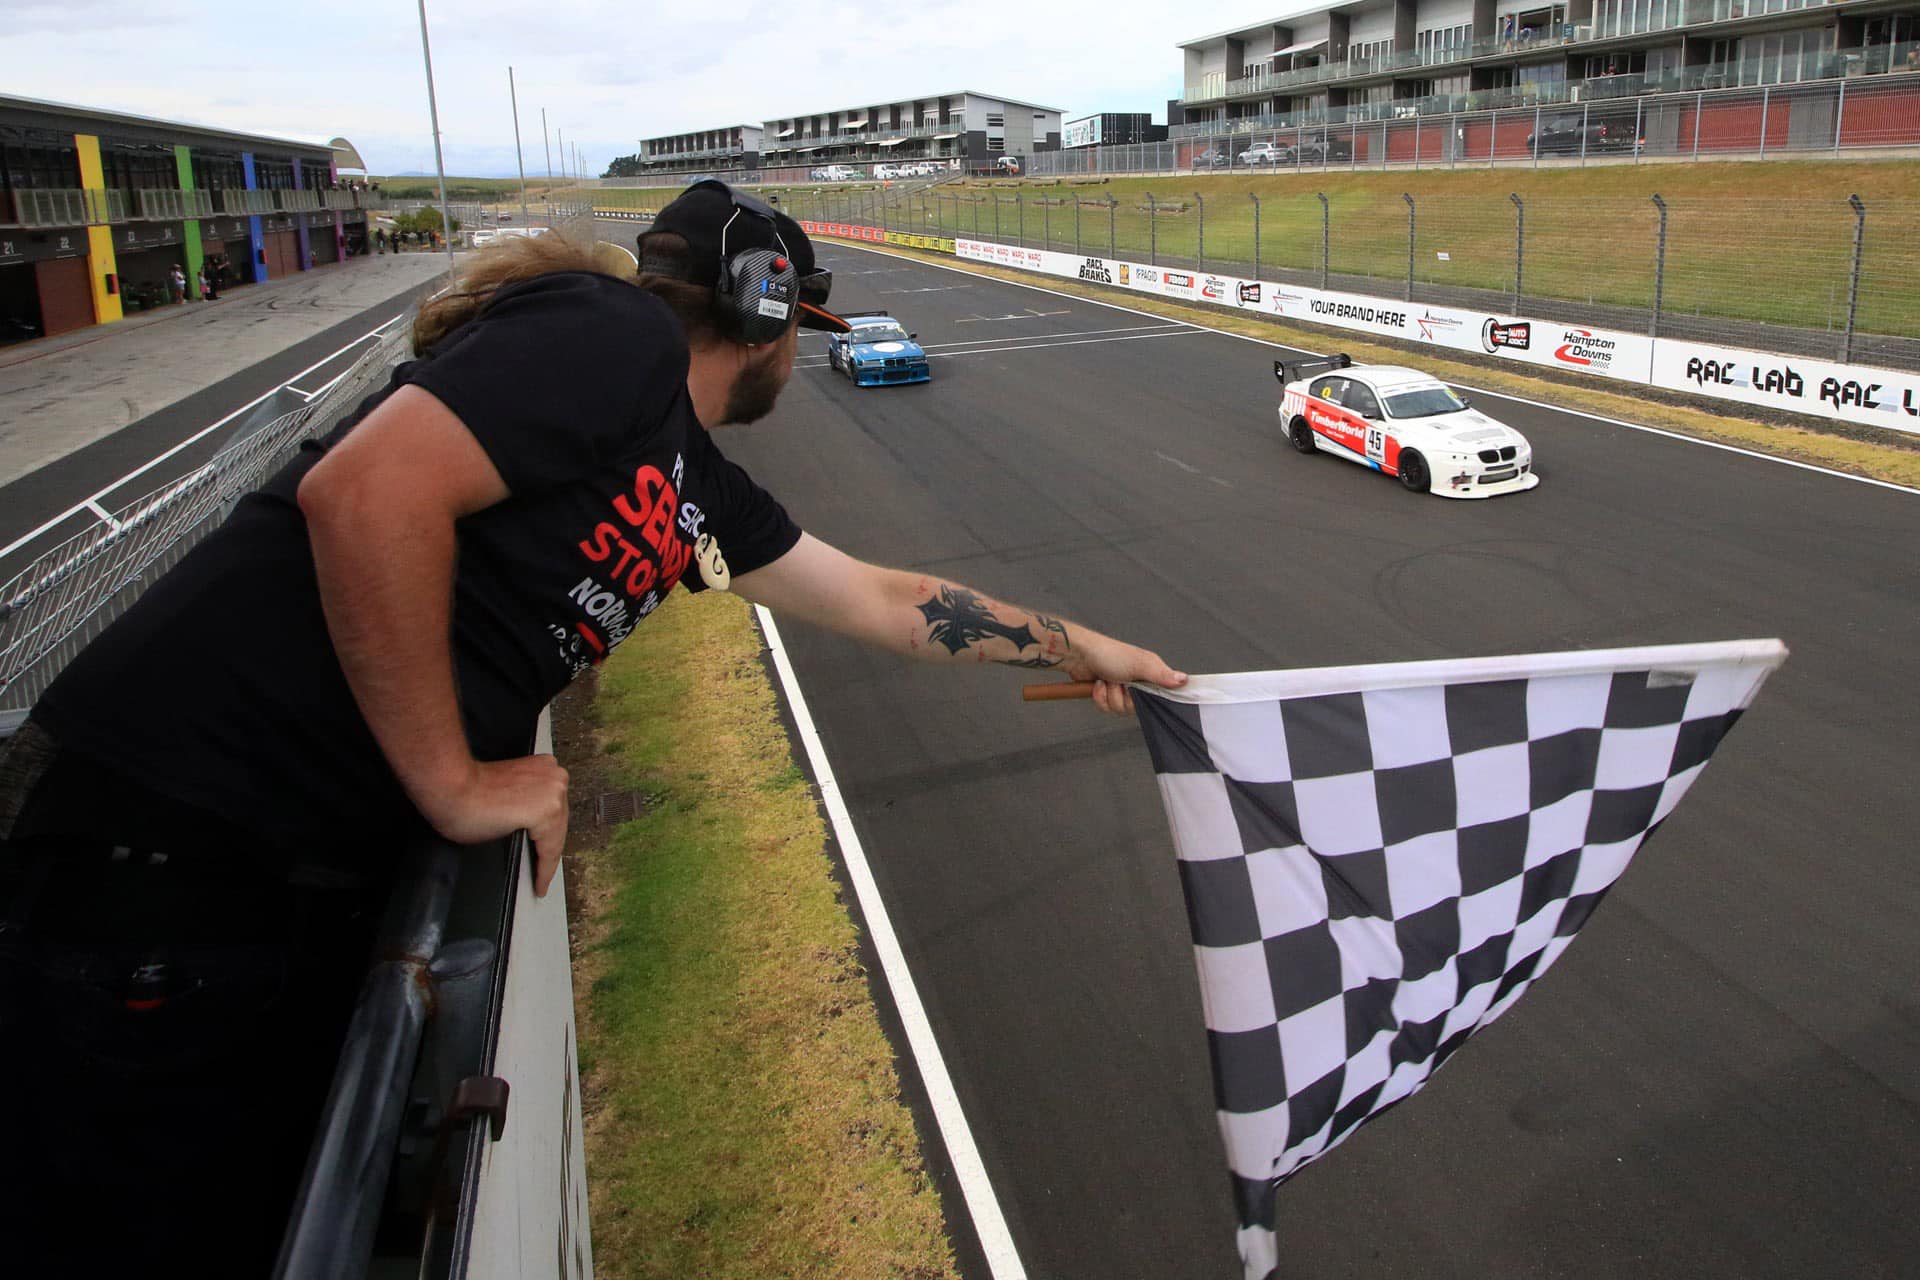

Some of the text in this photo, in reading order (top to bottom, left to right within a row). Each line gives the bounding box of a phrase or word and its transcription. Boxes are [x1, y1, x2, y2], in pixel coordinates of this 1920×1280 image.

[3, 241, 15, 255] 21
[60, 236, 70, 249] 22
[1086, 258, 1103, 270] RACE
[1078, 265, 1112, 284] BRAKES
[1310, 299, 1406, 328] YOUR BRAND HERE
[1563, 331, 1616, 349] Hampton
[1572, 345, 1612, 361] Downs
[1311, 411, 1365, 439] TimberWorld
[1368, 429, 1382, 451] 45
